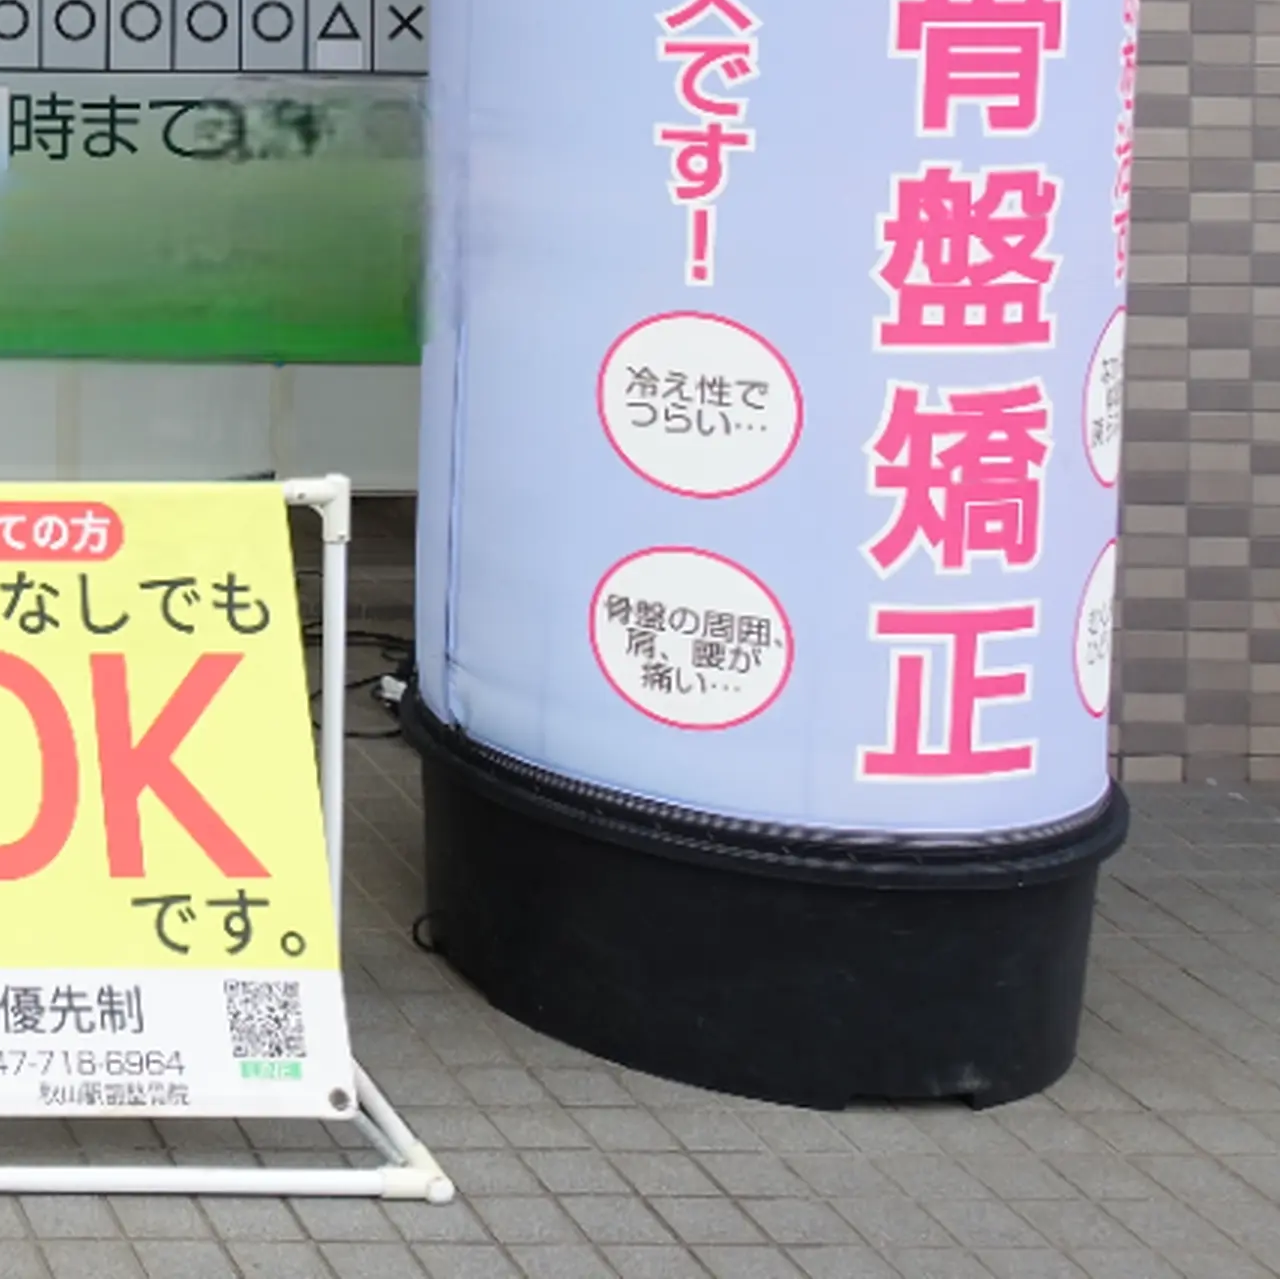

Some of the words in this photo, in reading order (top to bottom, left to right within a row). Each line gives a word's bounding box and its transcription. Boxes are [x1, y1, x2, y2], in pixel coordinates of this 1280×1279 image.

[626, 365, 768, 410] 冷え性で
[131, 888, 307, 958] です。
